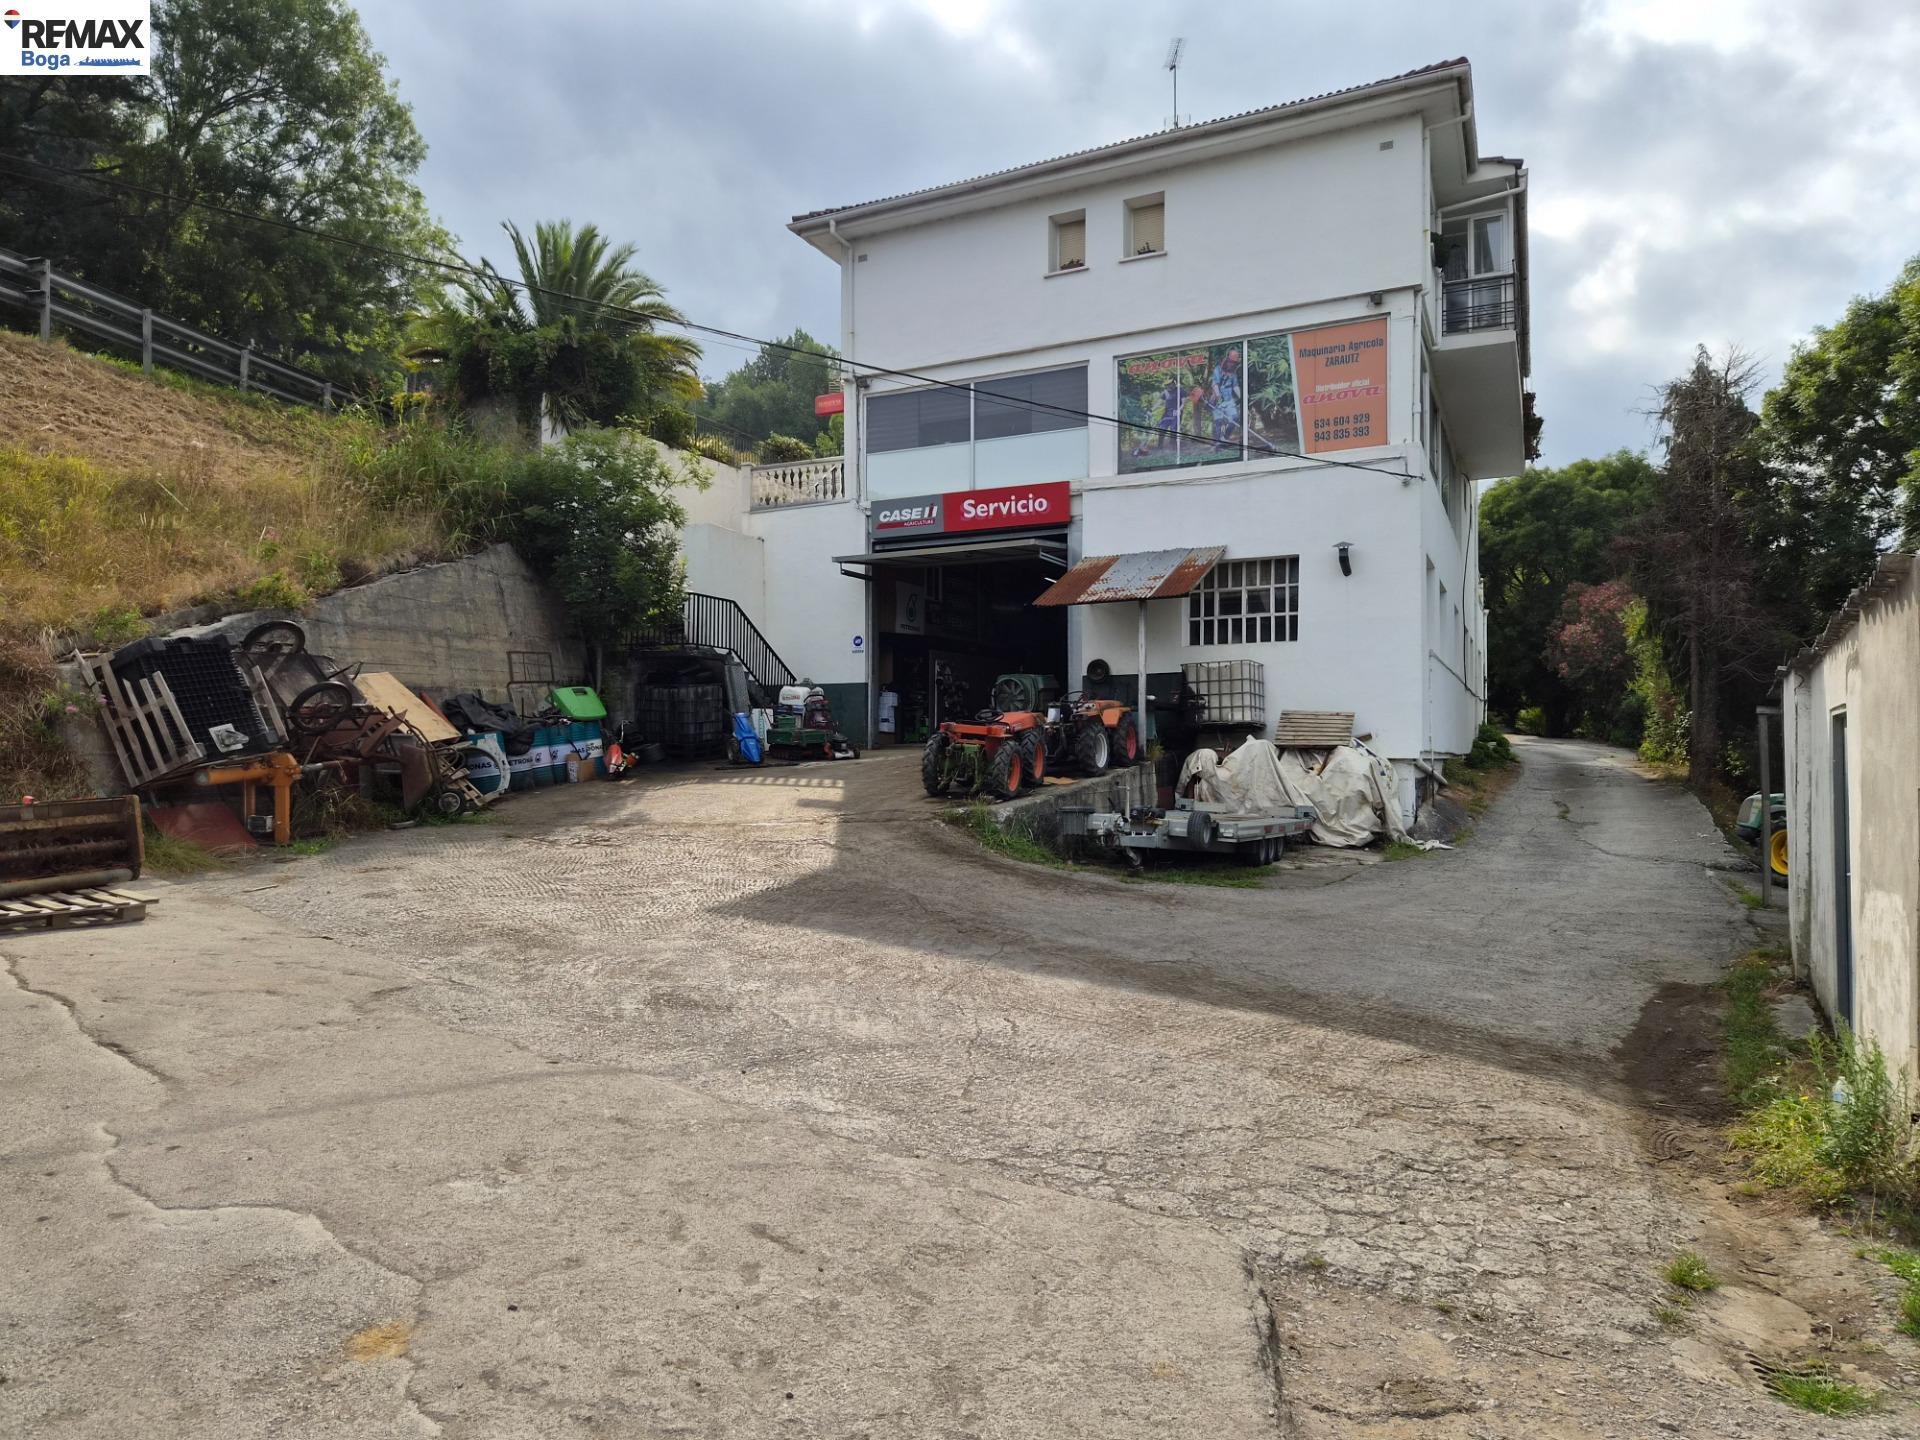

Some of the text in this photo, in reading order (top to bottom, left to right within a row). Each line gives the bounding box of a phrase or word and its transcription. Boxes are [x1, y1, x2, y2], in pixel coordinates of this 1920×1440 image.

[1300, 343, 1346, 358] Maquinaria
[1325, 353, 1360, 367] ZARAUTZ
[1303, 385, 1384, 405] anova
[1314, 418, 1331, 429] 634
[1353, 413, 1370, 424] 929
[1314, 426, 1370, 442] 943 835 393
[963, 493, 1048, 518] Servicio
[879, 505, 923, 523] CASE
